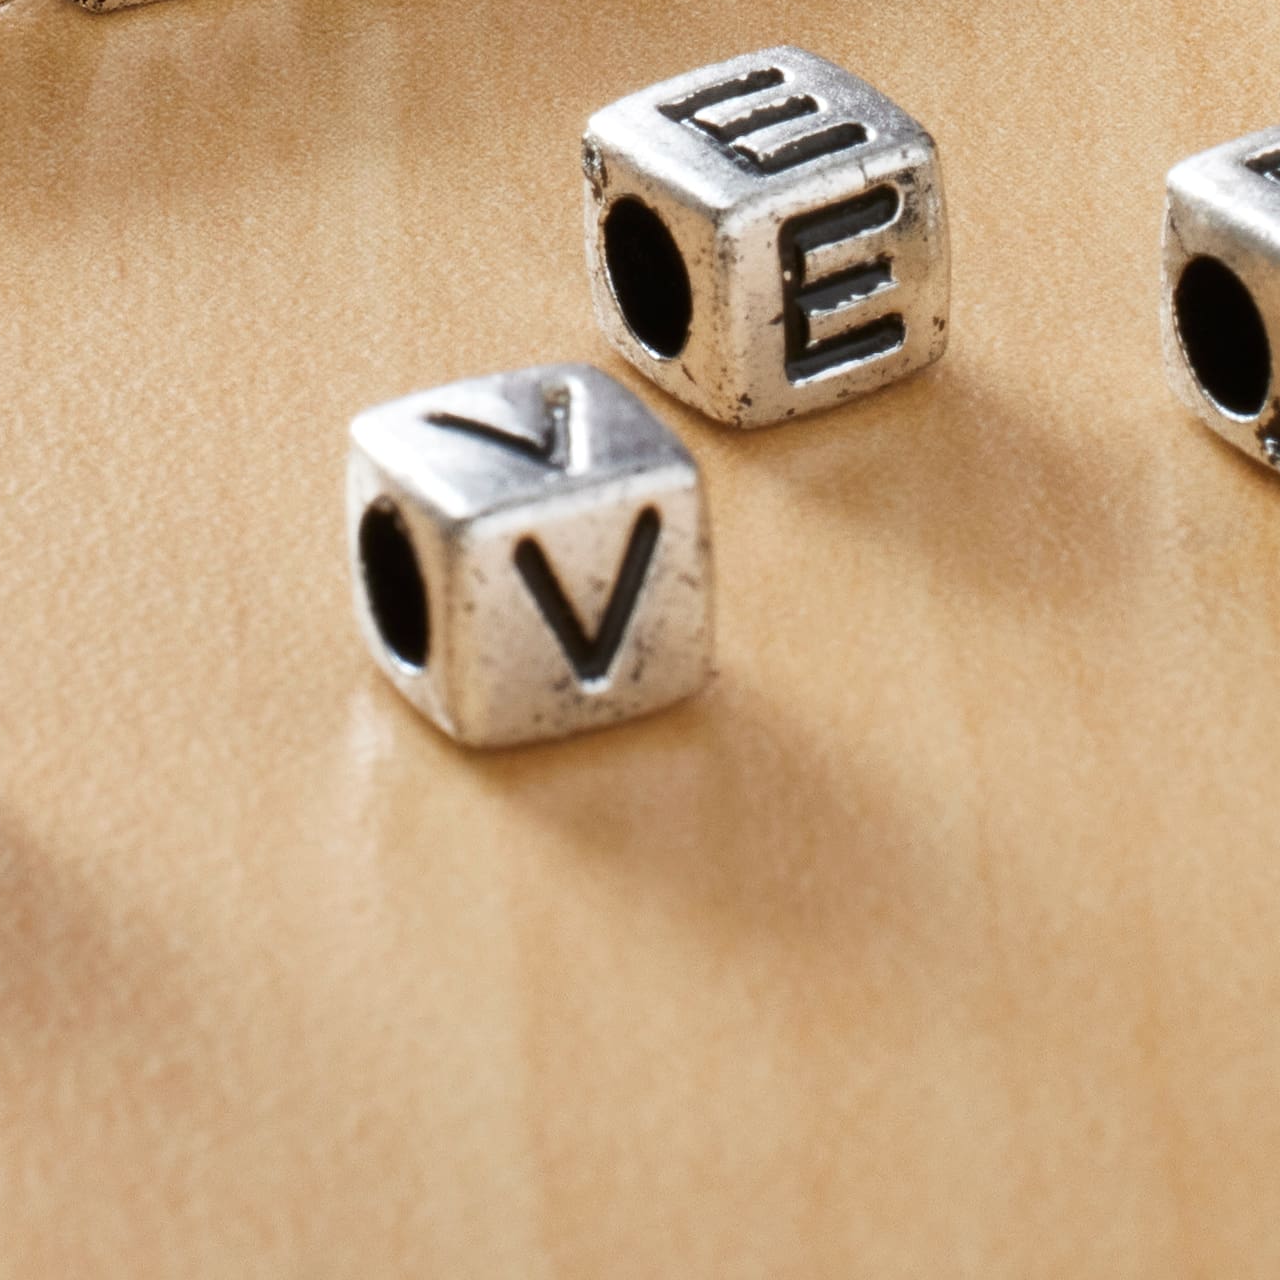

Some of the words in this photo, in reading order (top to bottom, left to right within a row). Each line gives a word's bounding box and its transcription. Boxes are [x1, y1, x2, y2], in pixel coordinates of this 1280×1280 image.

[655, 64, 882, 177] E
[775, 180, 908, 388] E
[418, 374, 594, 478] V
[512, 502, 663, 694] V
